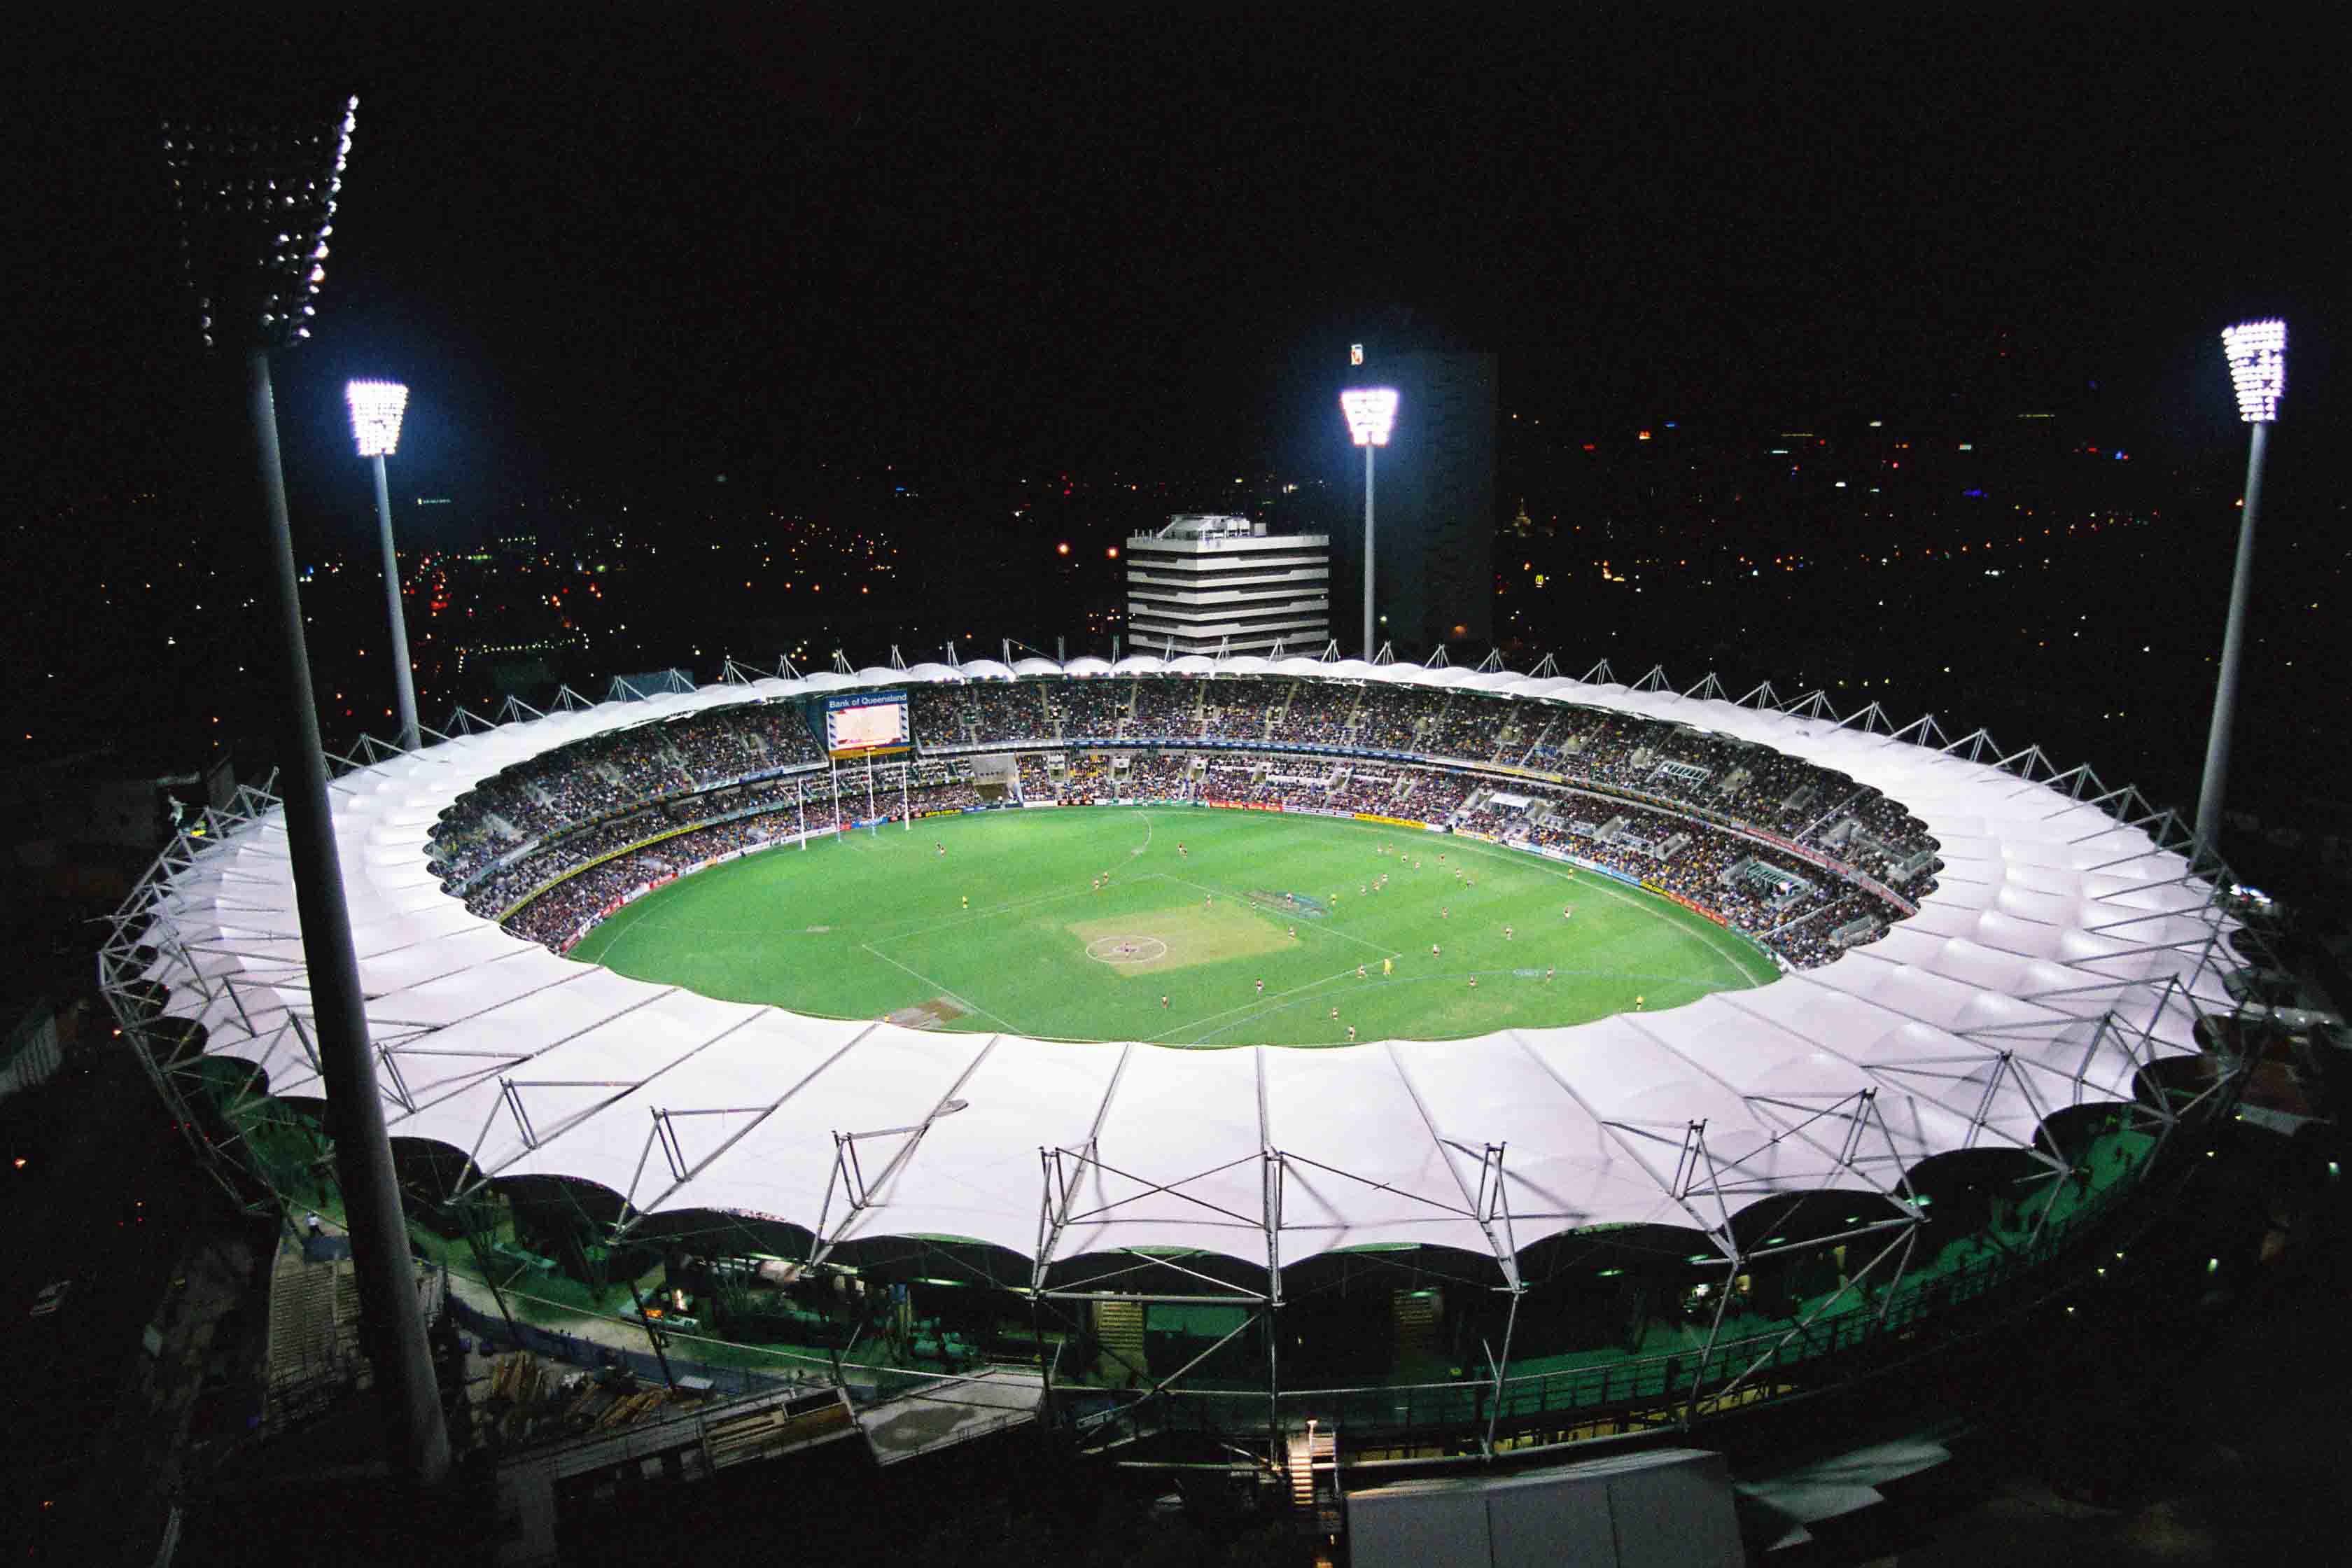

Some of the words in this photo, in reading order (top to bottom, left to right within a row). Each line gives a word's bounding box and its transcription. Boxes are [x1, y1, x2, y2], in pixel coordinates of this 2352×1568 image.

[829, 700, 850, 708] Bank
[851, 697, 860, 706] of
[862, 693, 907, 704] Queensland
